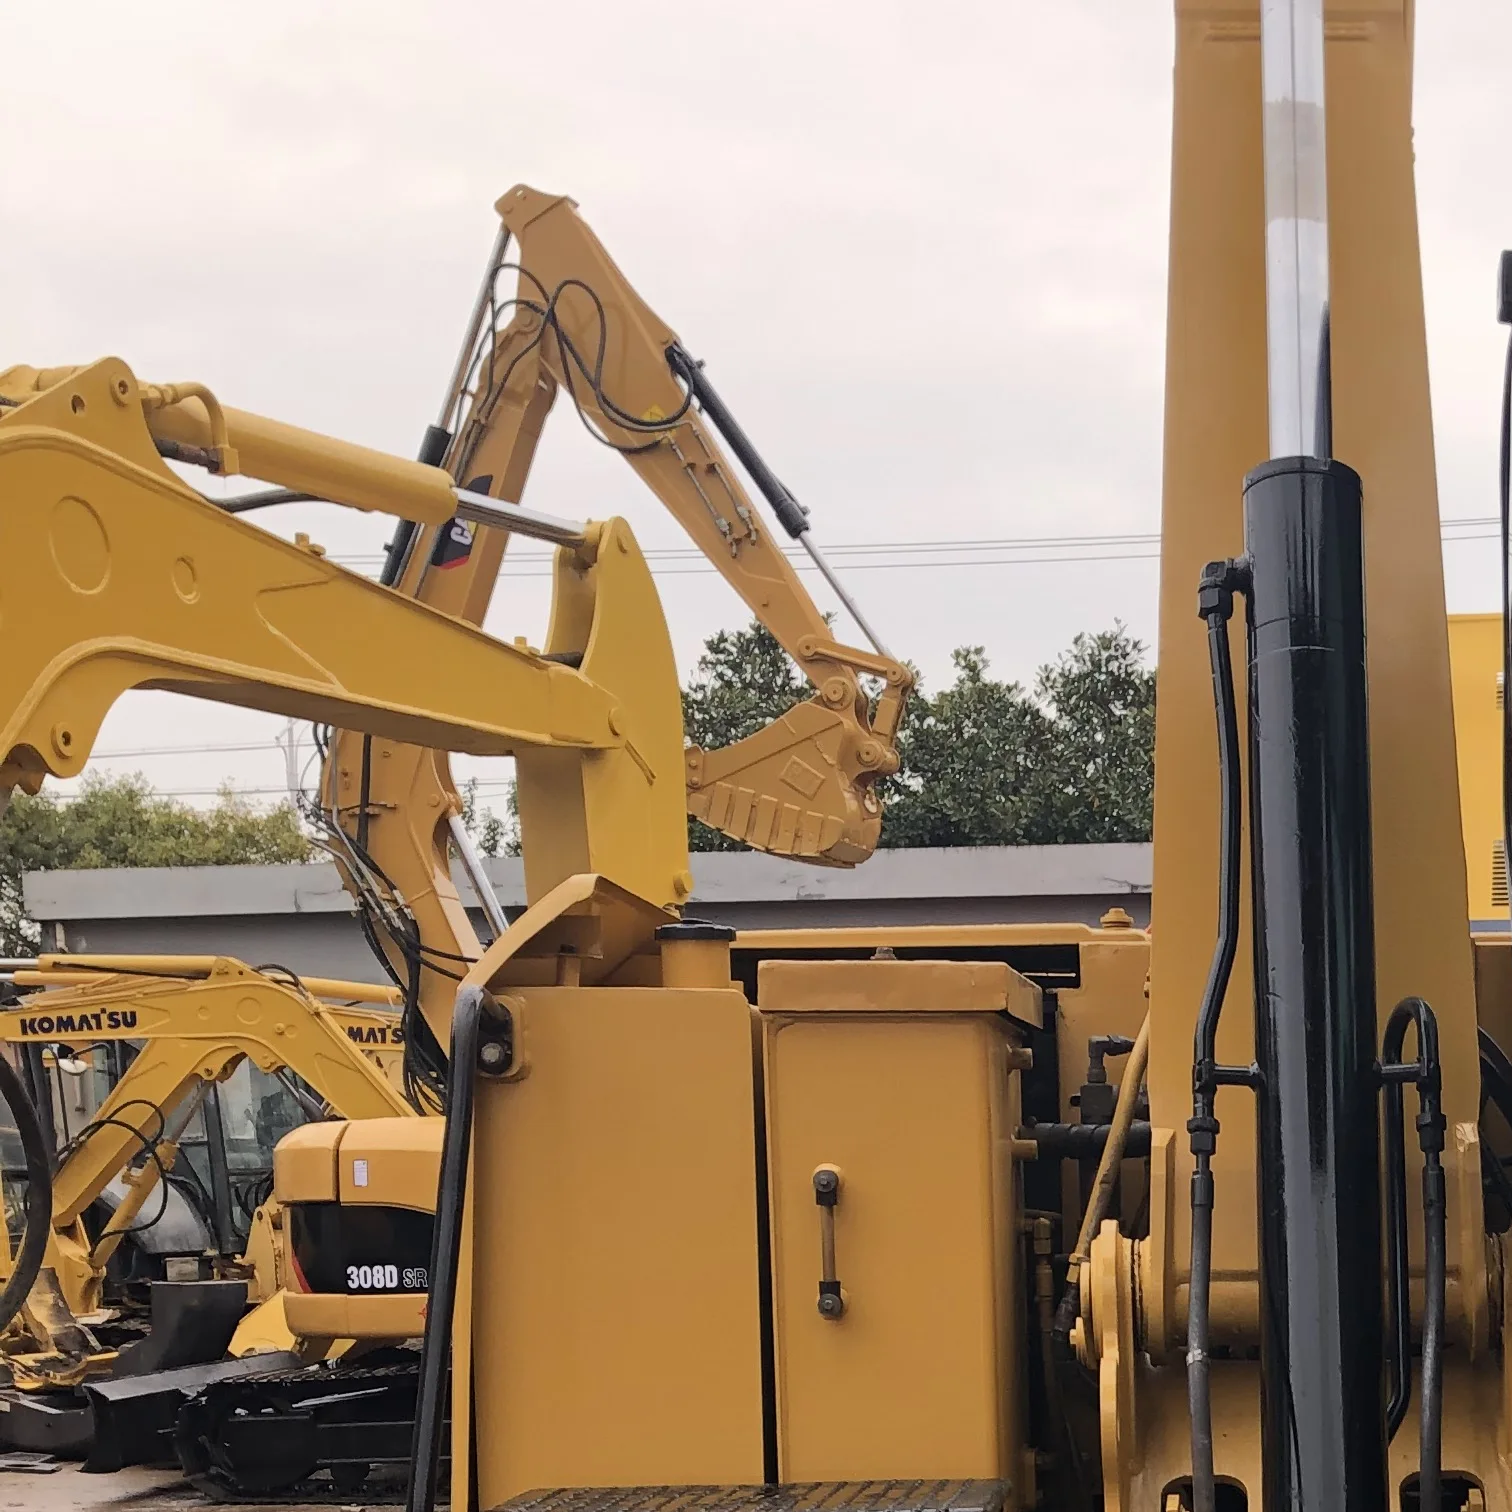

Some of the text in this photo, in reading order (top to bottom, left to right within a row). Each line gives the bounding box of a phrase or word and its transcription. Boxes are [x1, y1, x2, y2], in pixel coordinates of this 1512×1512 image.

[20, 1008, 137, 1035] KOMATSU
[345, 1024, 405, 1044] MATS
[346, 1265, 428, 1289] 308D SR
